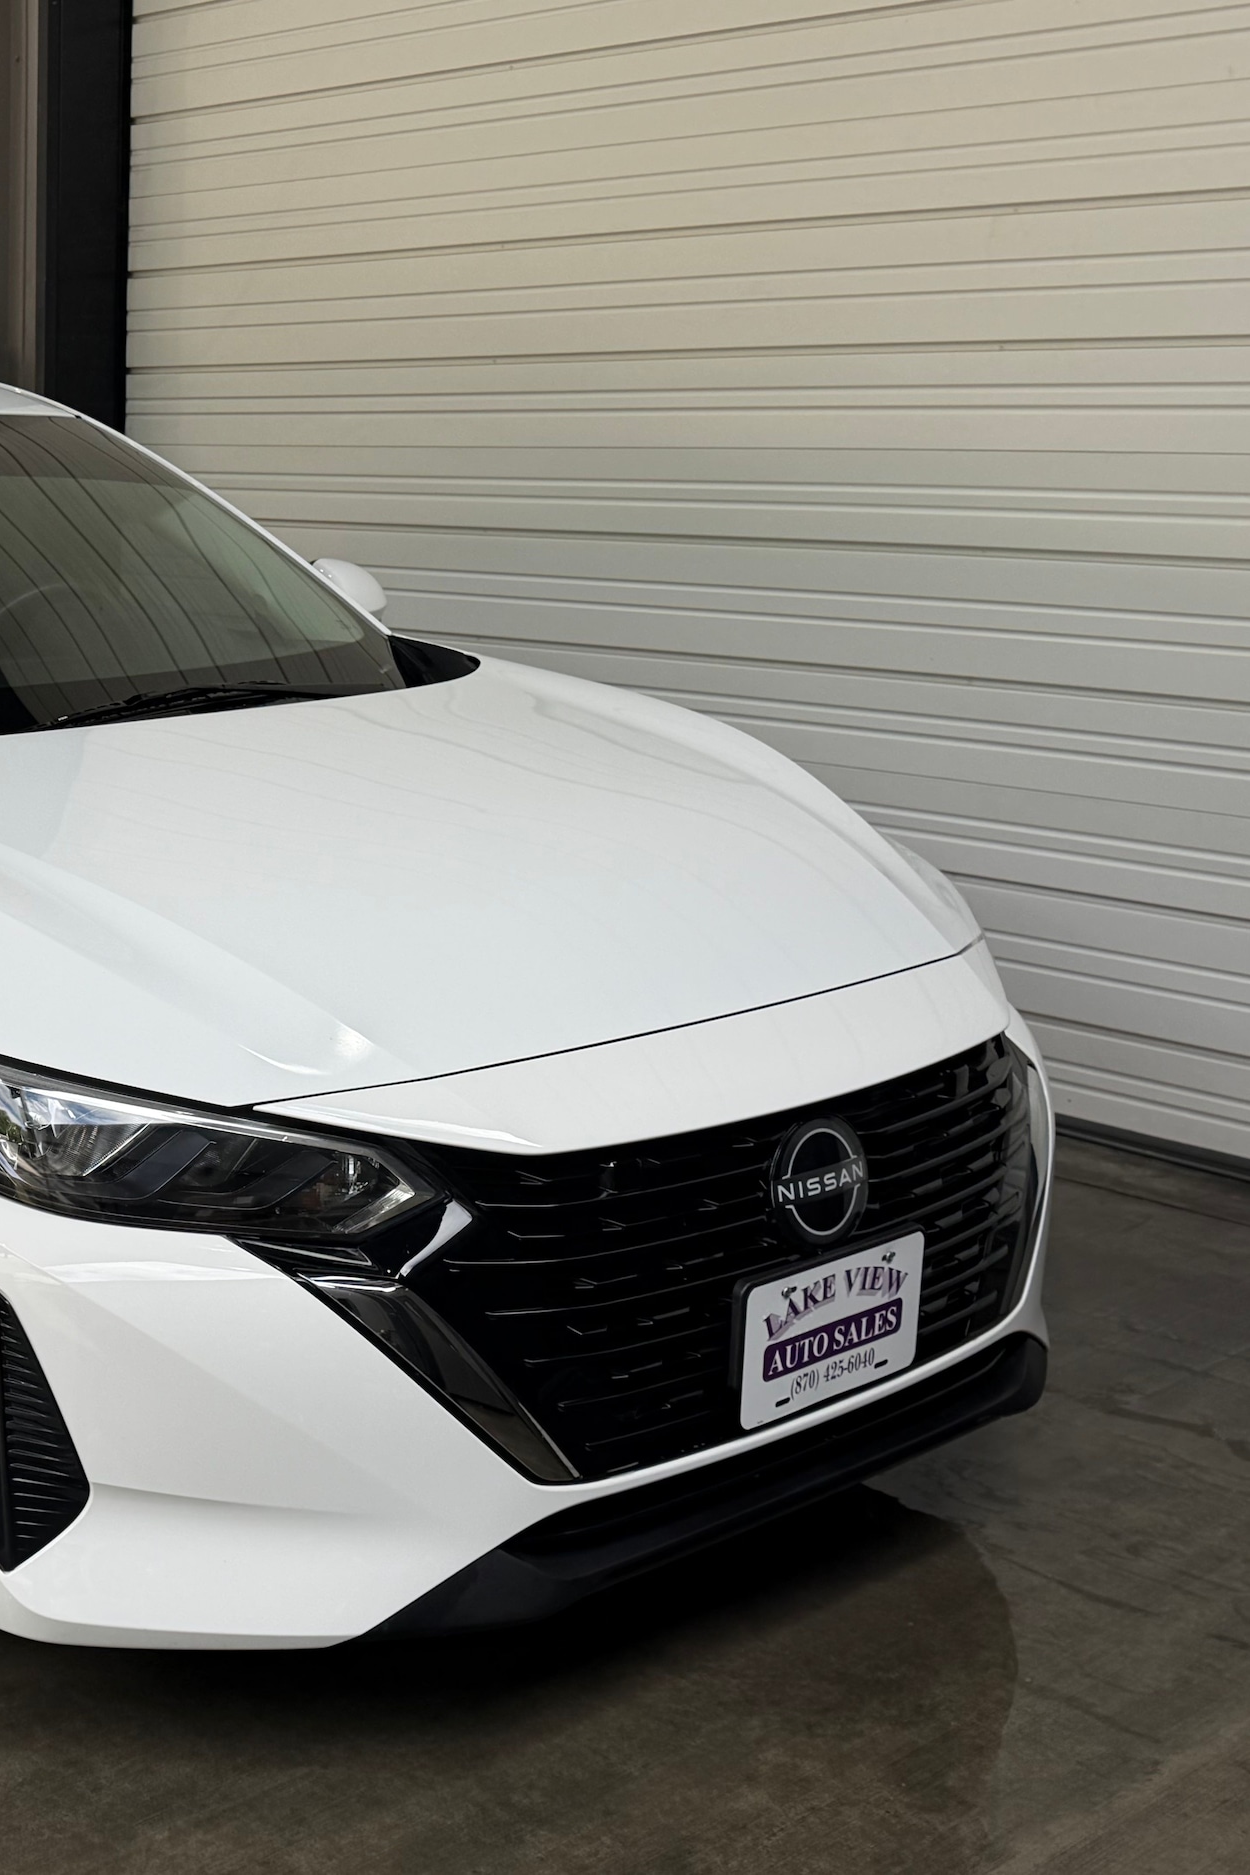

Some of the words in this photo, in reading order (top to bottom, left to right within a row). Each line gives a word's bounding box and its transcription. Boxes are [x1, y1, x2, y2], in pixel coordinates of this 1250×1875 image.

[777, 1160, 864, 1203] NISSAN
[763, 1273, 836, 1342] LAKE
[843, 1266, 908, 1298] VIEW
[768, 1338, 829, 1376] AUTO
[832, 1305, 899, 1352] SALES
[789, 1369, 820, 1401] (870)
[823, 1347, 876, 1383] 425-6040
